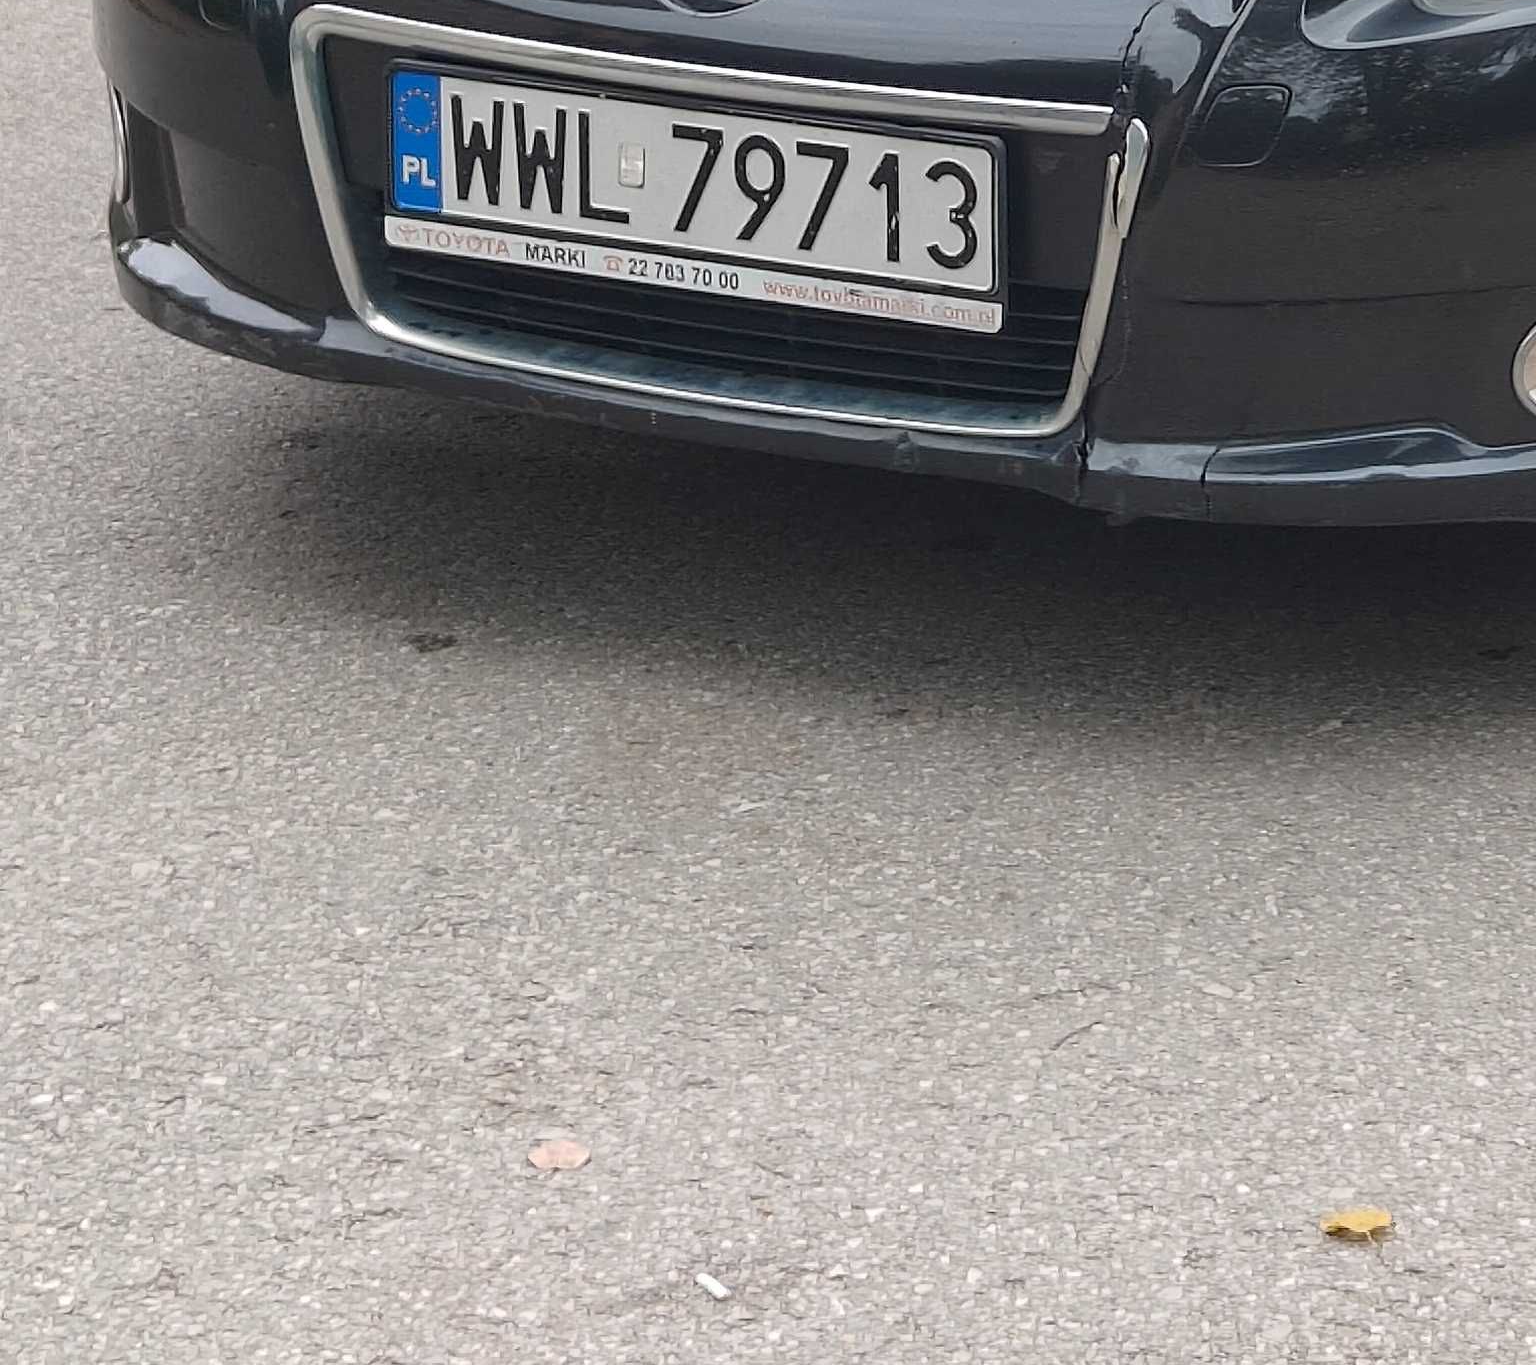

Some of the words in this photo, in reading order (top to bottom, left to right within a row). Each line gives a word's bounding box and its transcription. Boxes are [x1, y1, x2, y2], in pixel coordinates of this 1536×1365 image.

[401, 153, 435, 189] PL
[450, 94, 630, 225] WWL
[671, 122, 979, 270] 79713
[421, 227, 511, 258] TOYOTA
[525, 242, 586, 269] MARKI
[627, 257, 649, 277] 22
[691, 266, 713, 287] 70
[718, 271, 740, 291] 00
